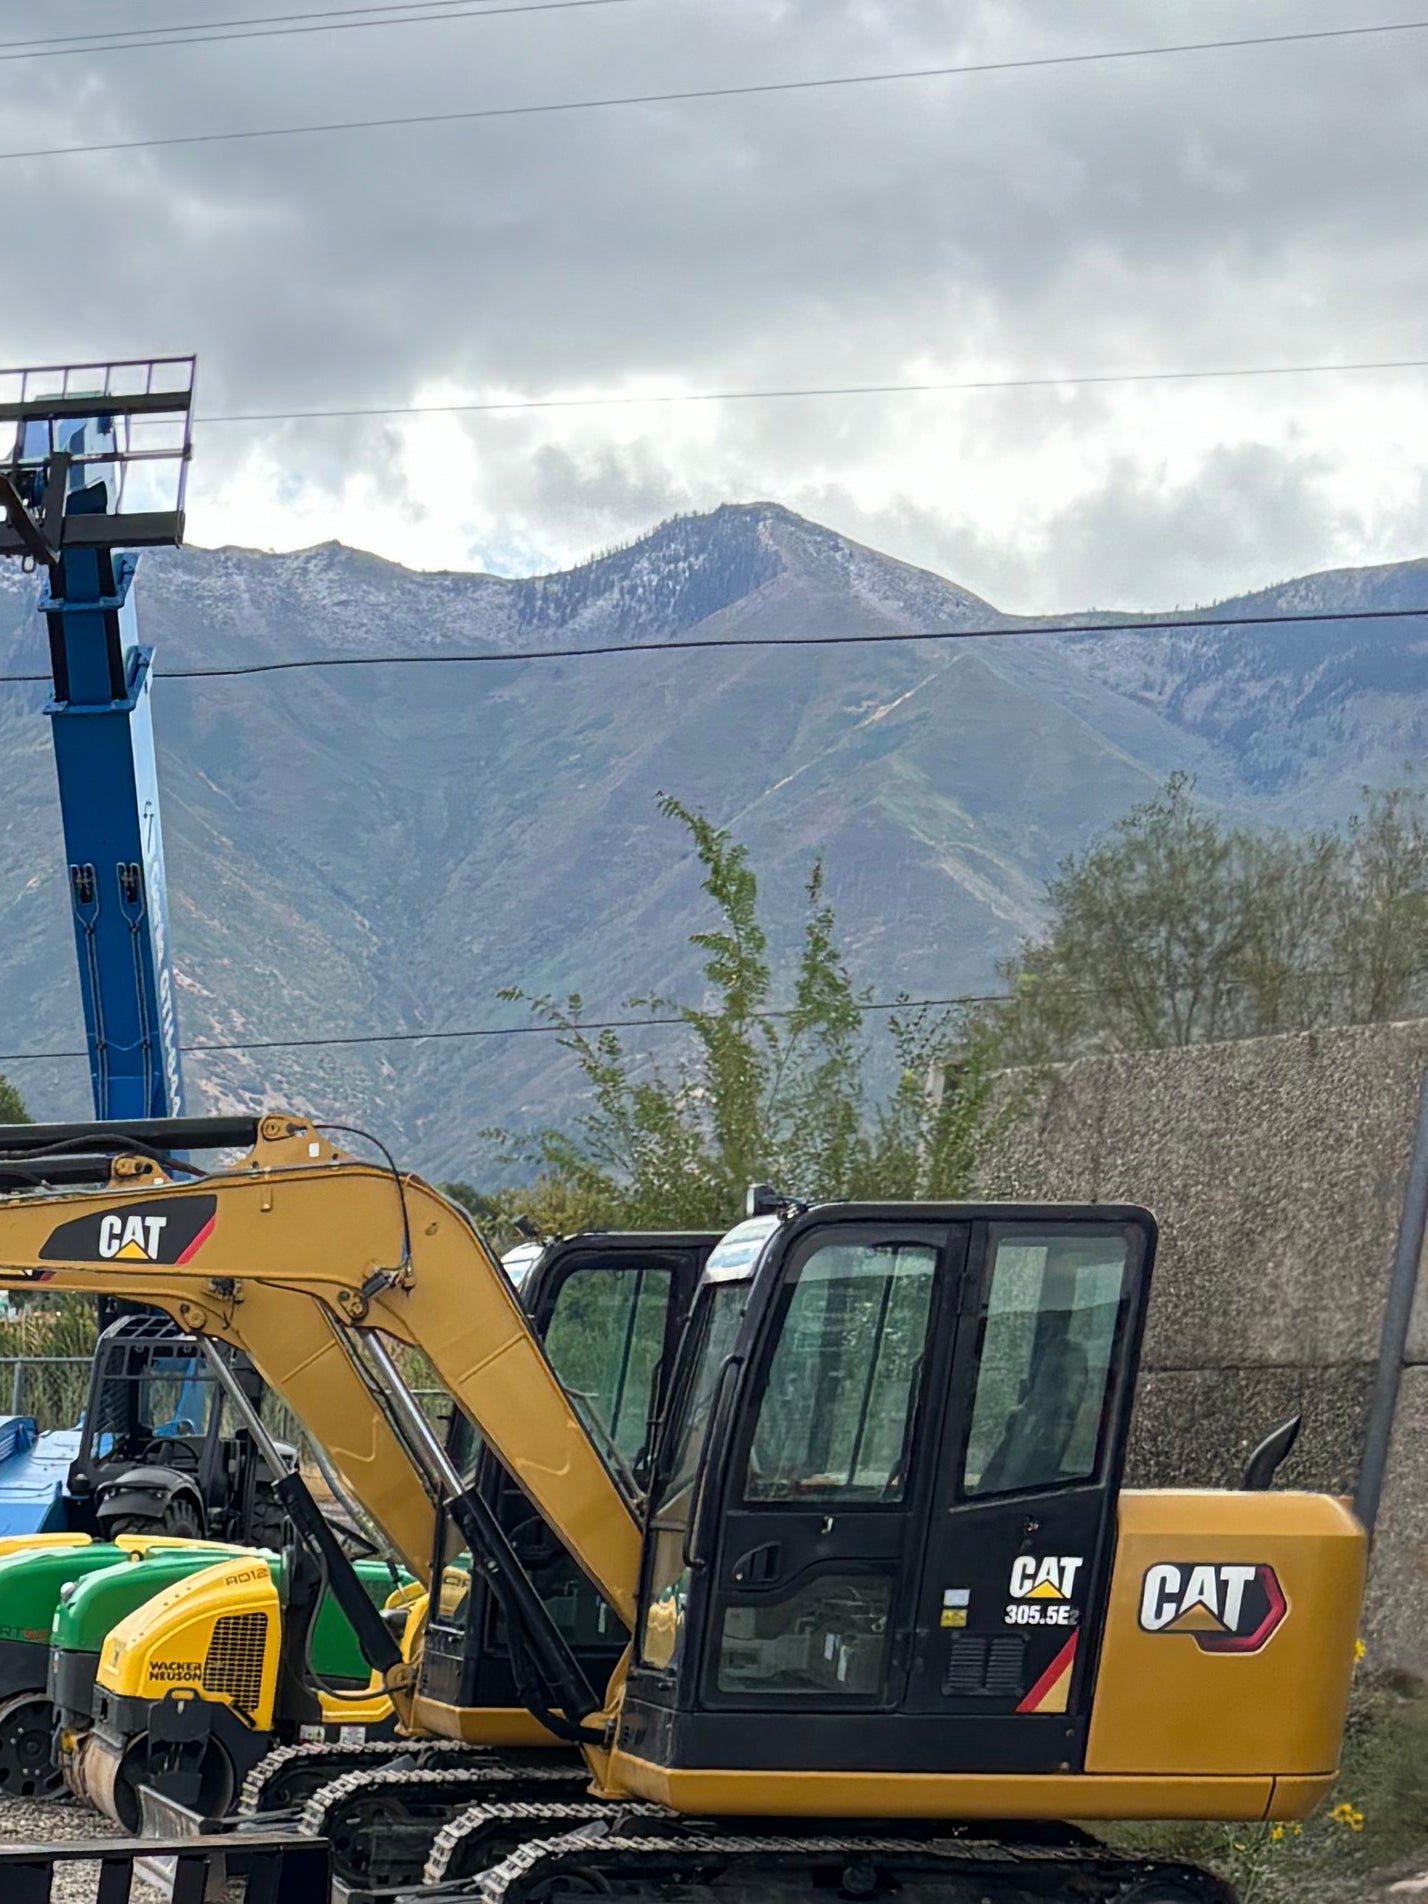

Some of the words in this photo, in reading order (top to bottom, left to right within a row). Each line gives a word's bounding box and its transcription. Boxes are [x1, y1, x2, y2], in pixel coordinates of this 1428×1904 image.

[98, 1214, 168, 1260] CAT
[1008, 1555, 1084, 1599] CAT
[1140, 1564, 1256, 1632] CAT
[149, 1661, 202, 1672] WACKER
[149, 1671, 202, 1682] NEUSON
